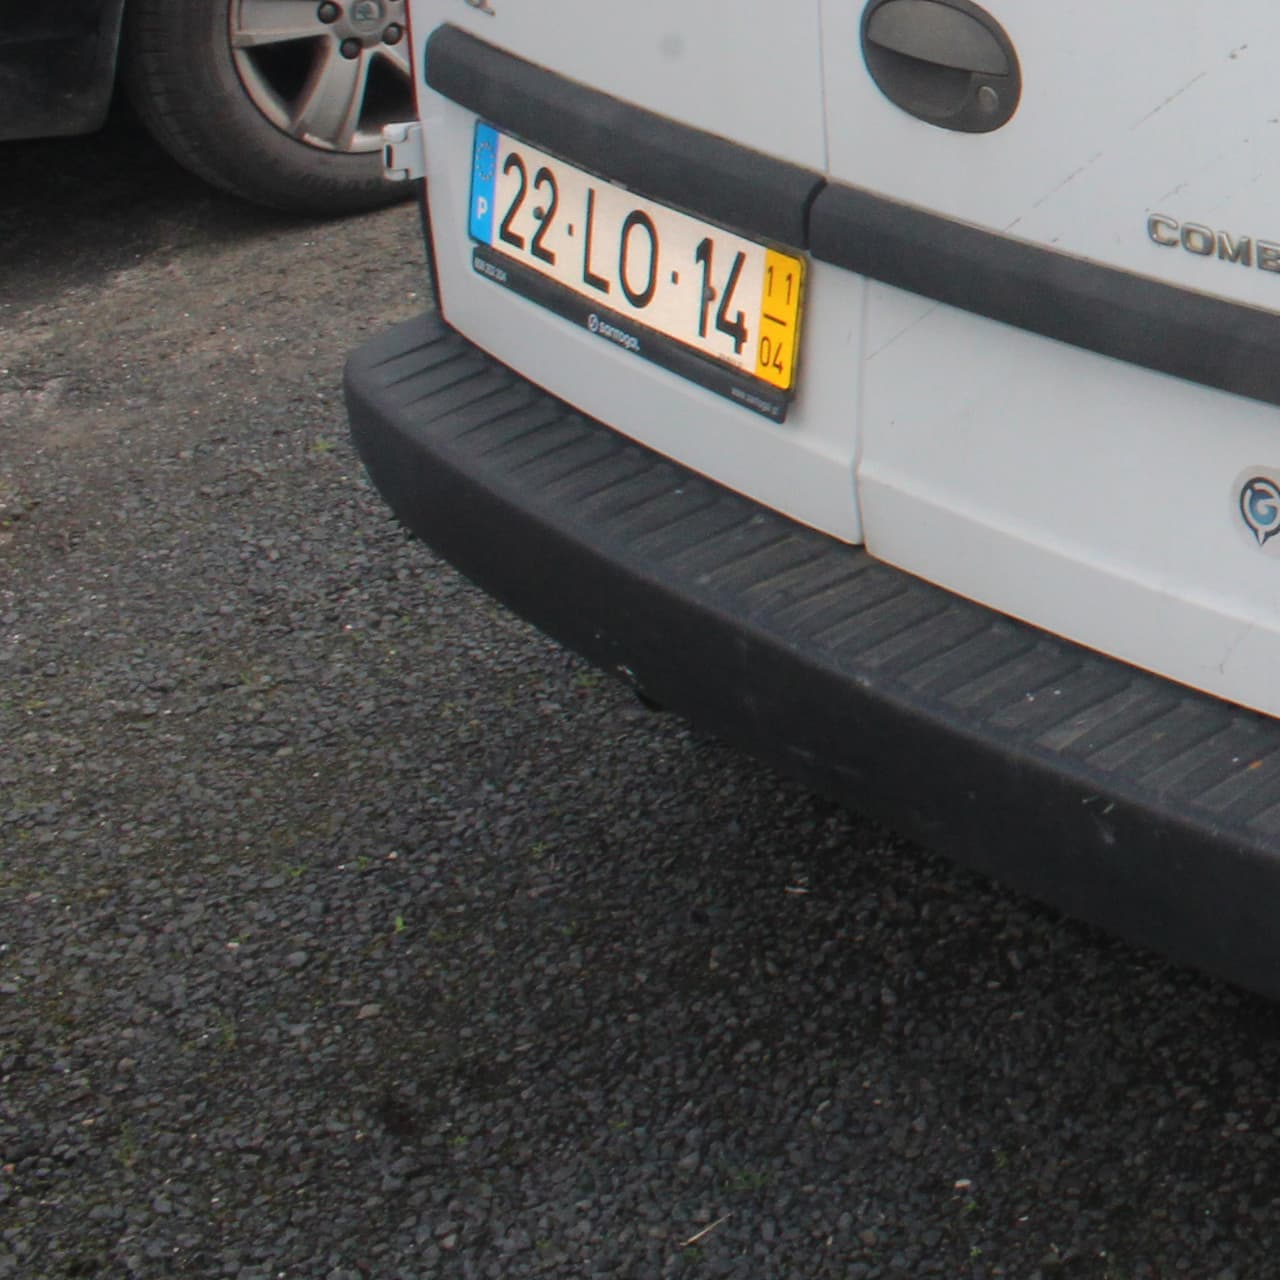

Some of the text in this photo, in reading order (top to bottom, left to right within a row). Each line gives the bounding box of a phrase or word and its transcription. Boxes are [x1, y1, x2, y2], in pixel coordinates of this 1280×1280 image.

[475, 196, 488, 219] P
[767, 266, 793, 305] 11
[760, 336, 784, 375] 04
